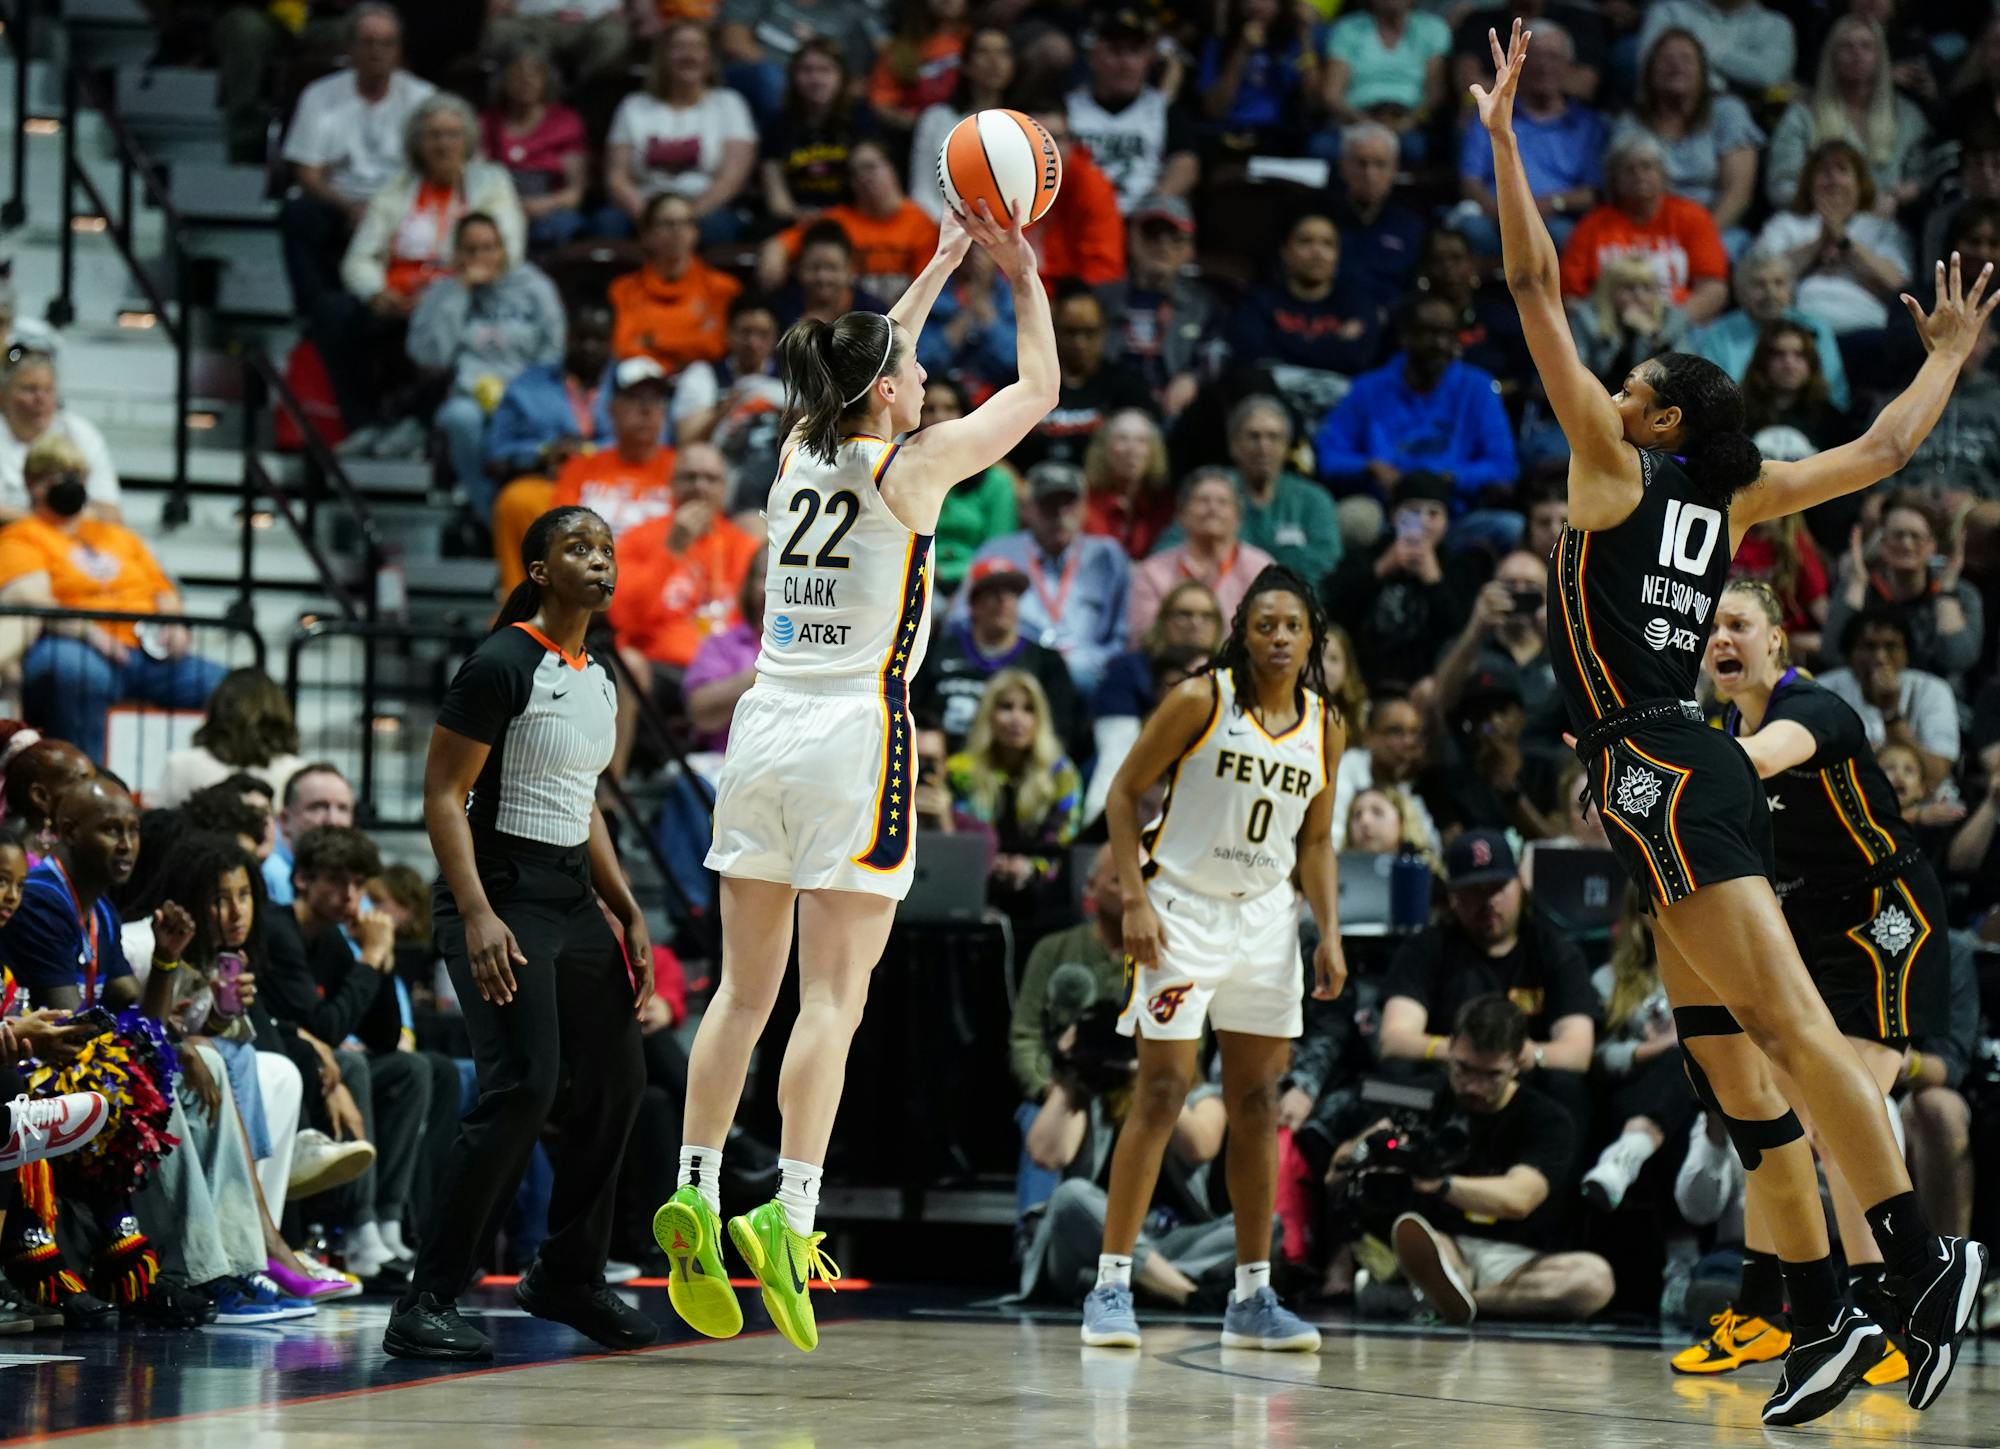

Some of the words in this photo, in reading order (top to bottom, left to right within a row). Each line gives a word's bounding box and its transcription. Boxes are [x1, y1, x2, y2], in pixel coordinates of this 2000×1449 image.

[779, 487, 861, 569] 22
[1658, 498, 1722, 577] 10
[784, 576, 837, 607] CLARK
[798, 623, 852, 645] AT&T
[1215, 749, 1312, 798] FEVER
[1247, 798, 1274, 844] 0
